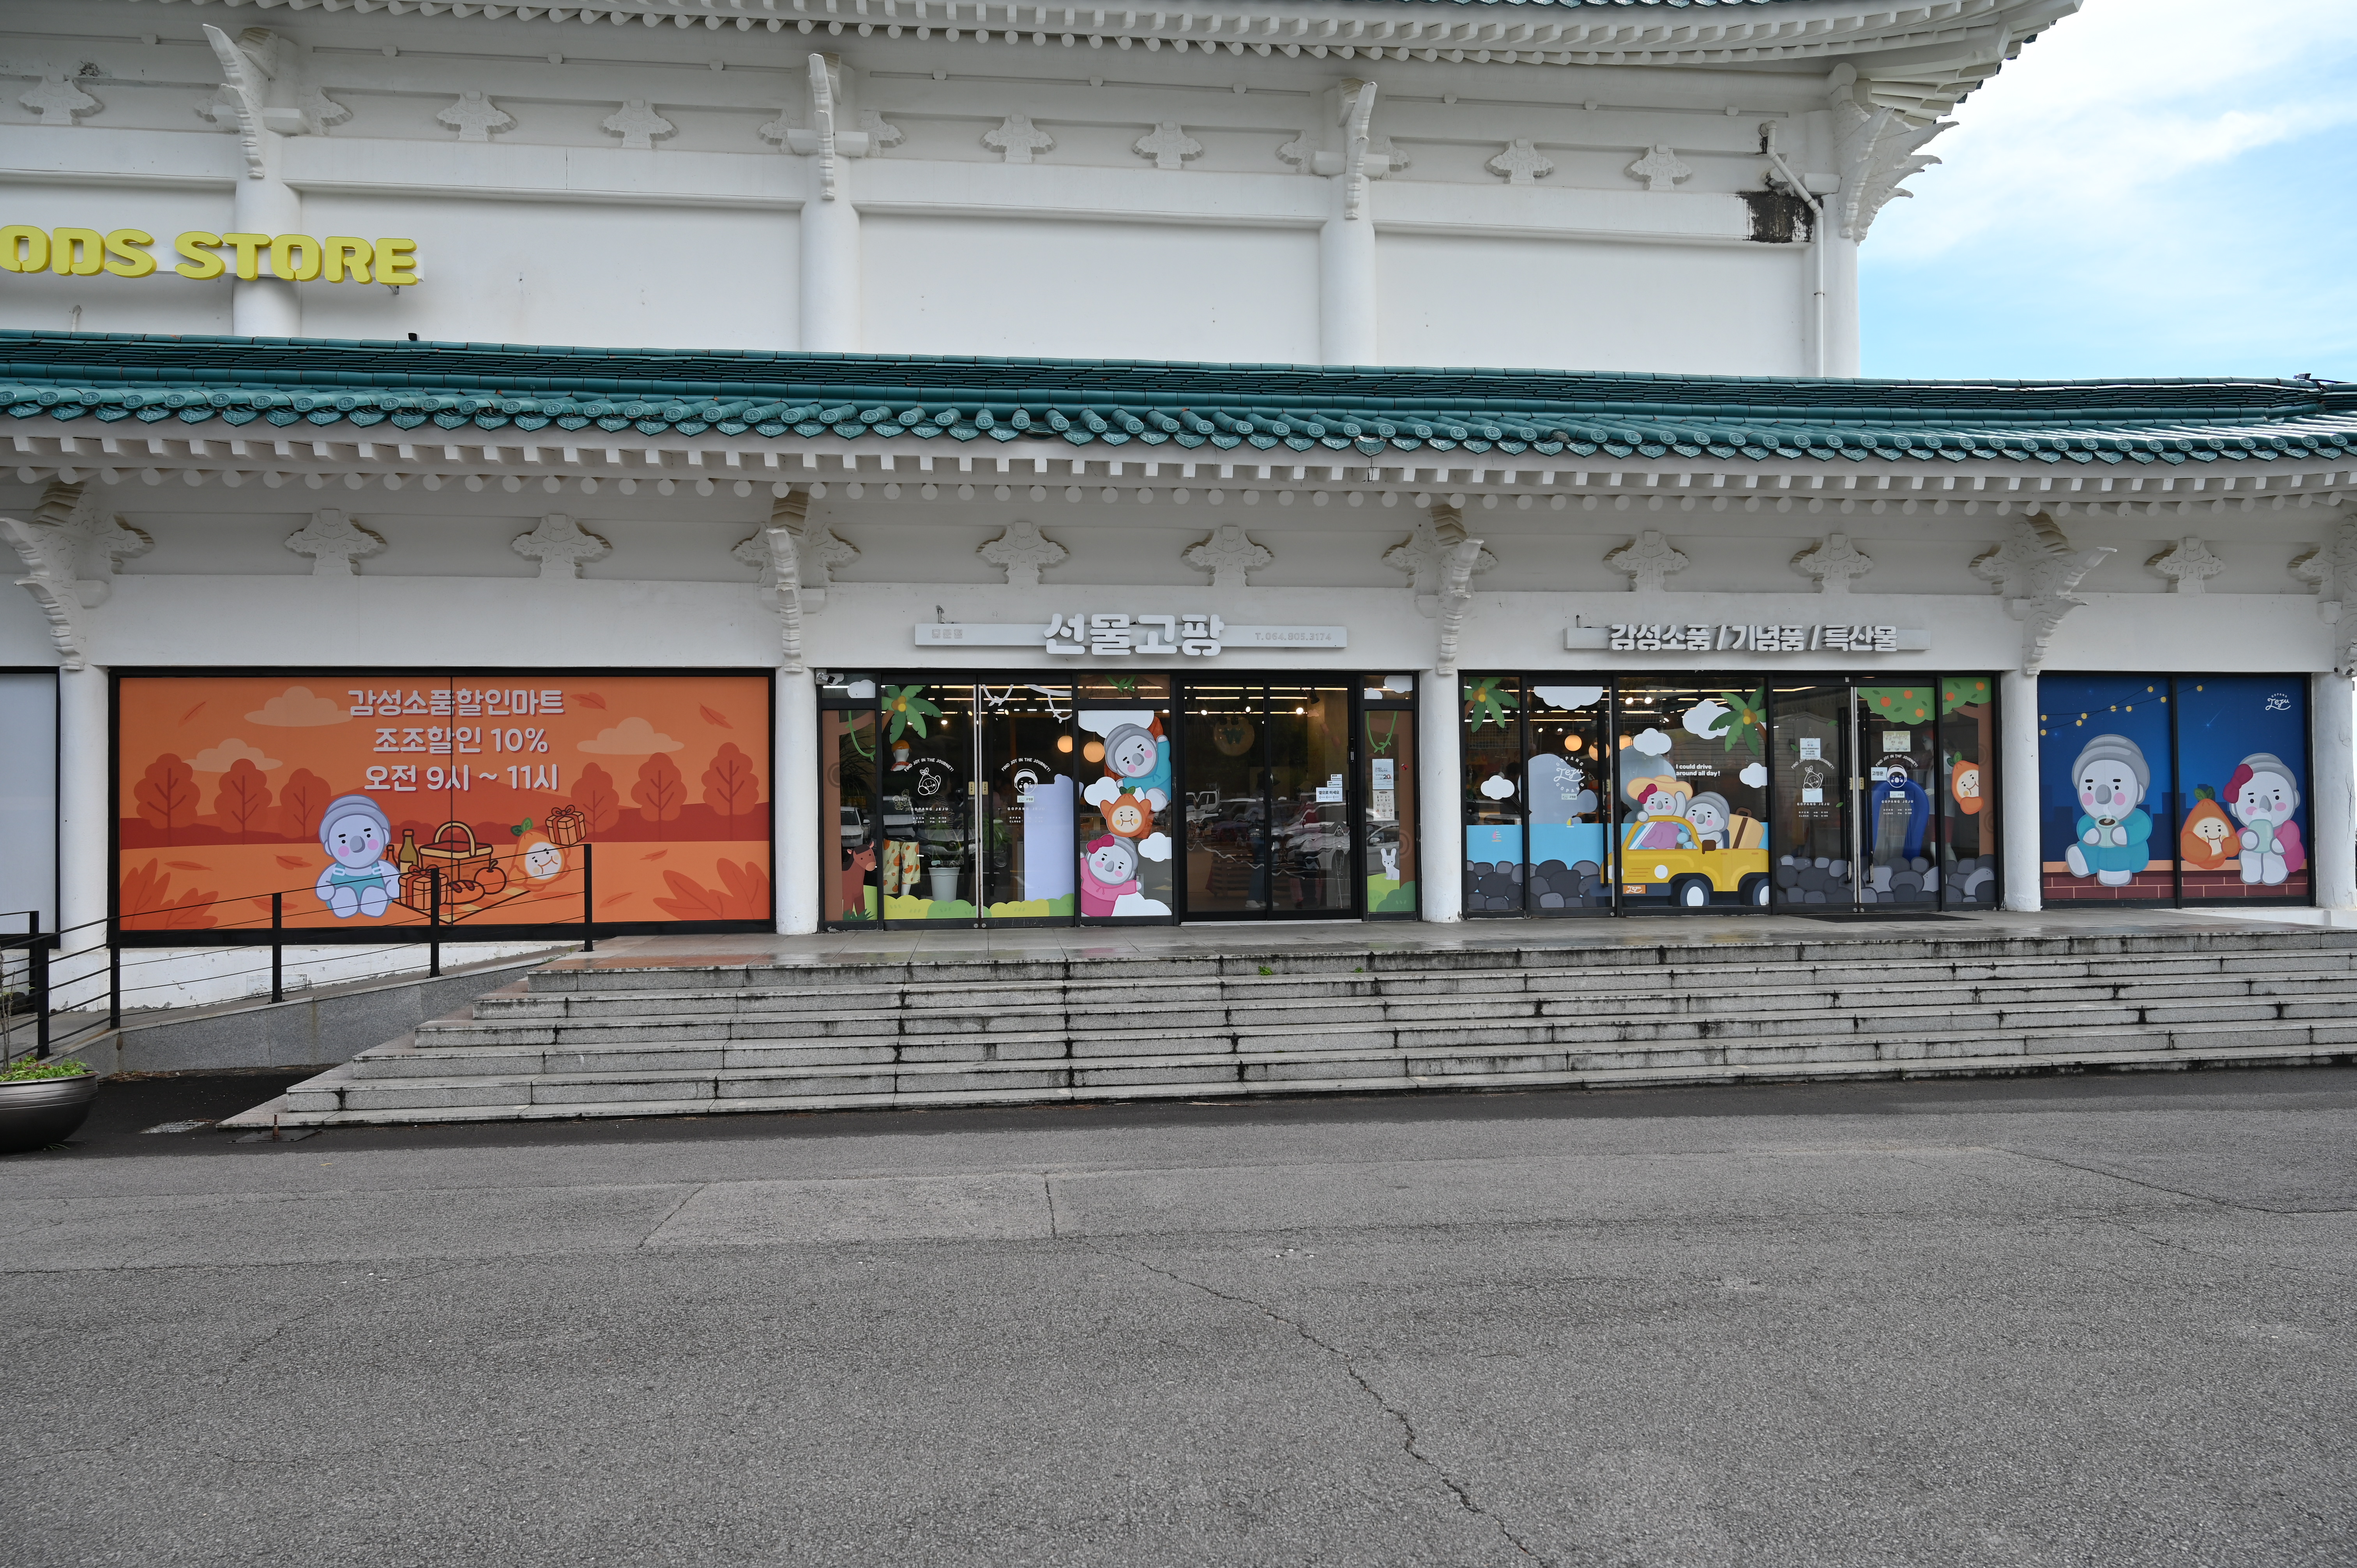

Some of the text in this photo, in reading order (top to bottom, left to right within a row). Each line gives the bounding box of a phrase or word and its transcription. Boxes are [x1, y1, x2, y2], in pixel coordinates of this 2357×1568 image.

[0, 225, 418, 286] ODS STORE
[1043, 613, 1224, 656] 선물고팡
[348, 688, 565, 716] 감성소품할인마트
[373, 726, 549, 754] 조조할인 10%
[904, 763, 912, 772] FIND
[1001, 763, 1010, 772] FIND
[1556, 756, 1584, 766] GOPANG
[364, 765, 417, 791] 오전
[426, 764, 470, 791] 9시
[507, 764, 558, 791] 11시
[1553, 768, 1585, 782] Jeju
[1556, 782, 1584, 793] GOPANG
